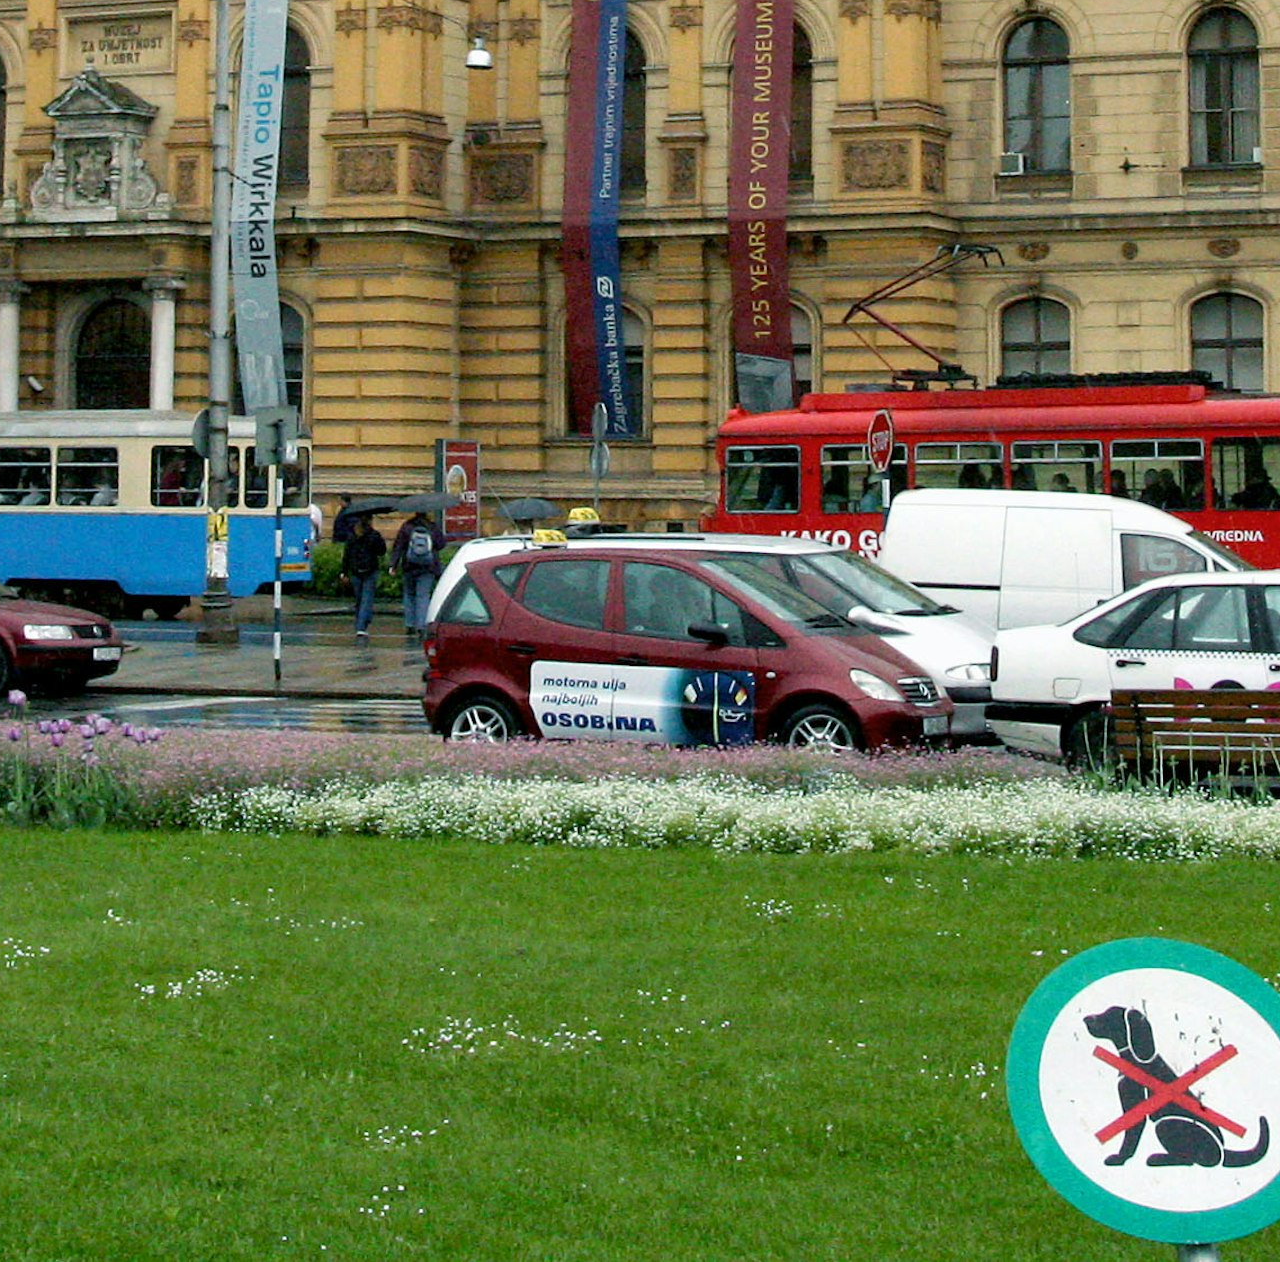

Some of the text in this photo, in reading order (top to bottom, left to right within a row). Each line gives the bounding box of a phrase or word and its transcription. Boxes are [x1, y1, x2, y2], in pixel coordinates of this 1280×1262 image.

[81, 41, 95, 53] ZA
[599, 16, 620, 198] Partner trajnim vrijednostima
[248, 64, 280, 278] Tapio Wirkkala
[747, 2, 774, 339] 125 YEARS OF YOUR MUSEUM
[603, 304, 628, 434] Zagrebačka banka
[1203, 530, 1265, 542] VREDNA
[541, 693, 599, 706] najboljih
[543, 677, 627, 691] motorna ulja
